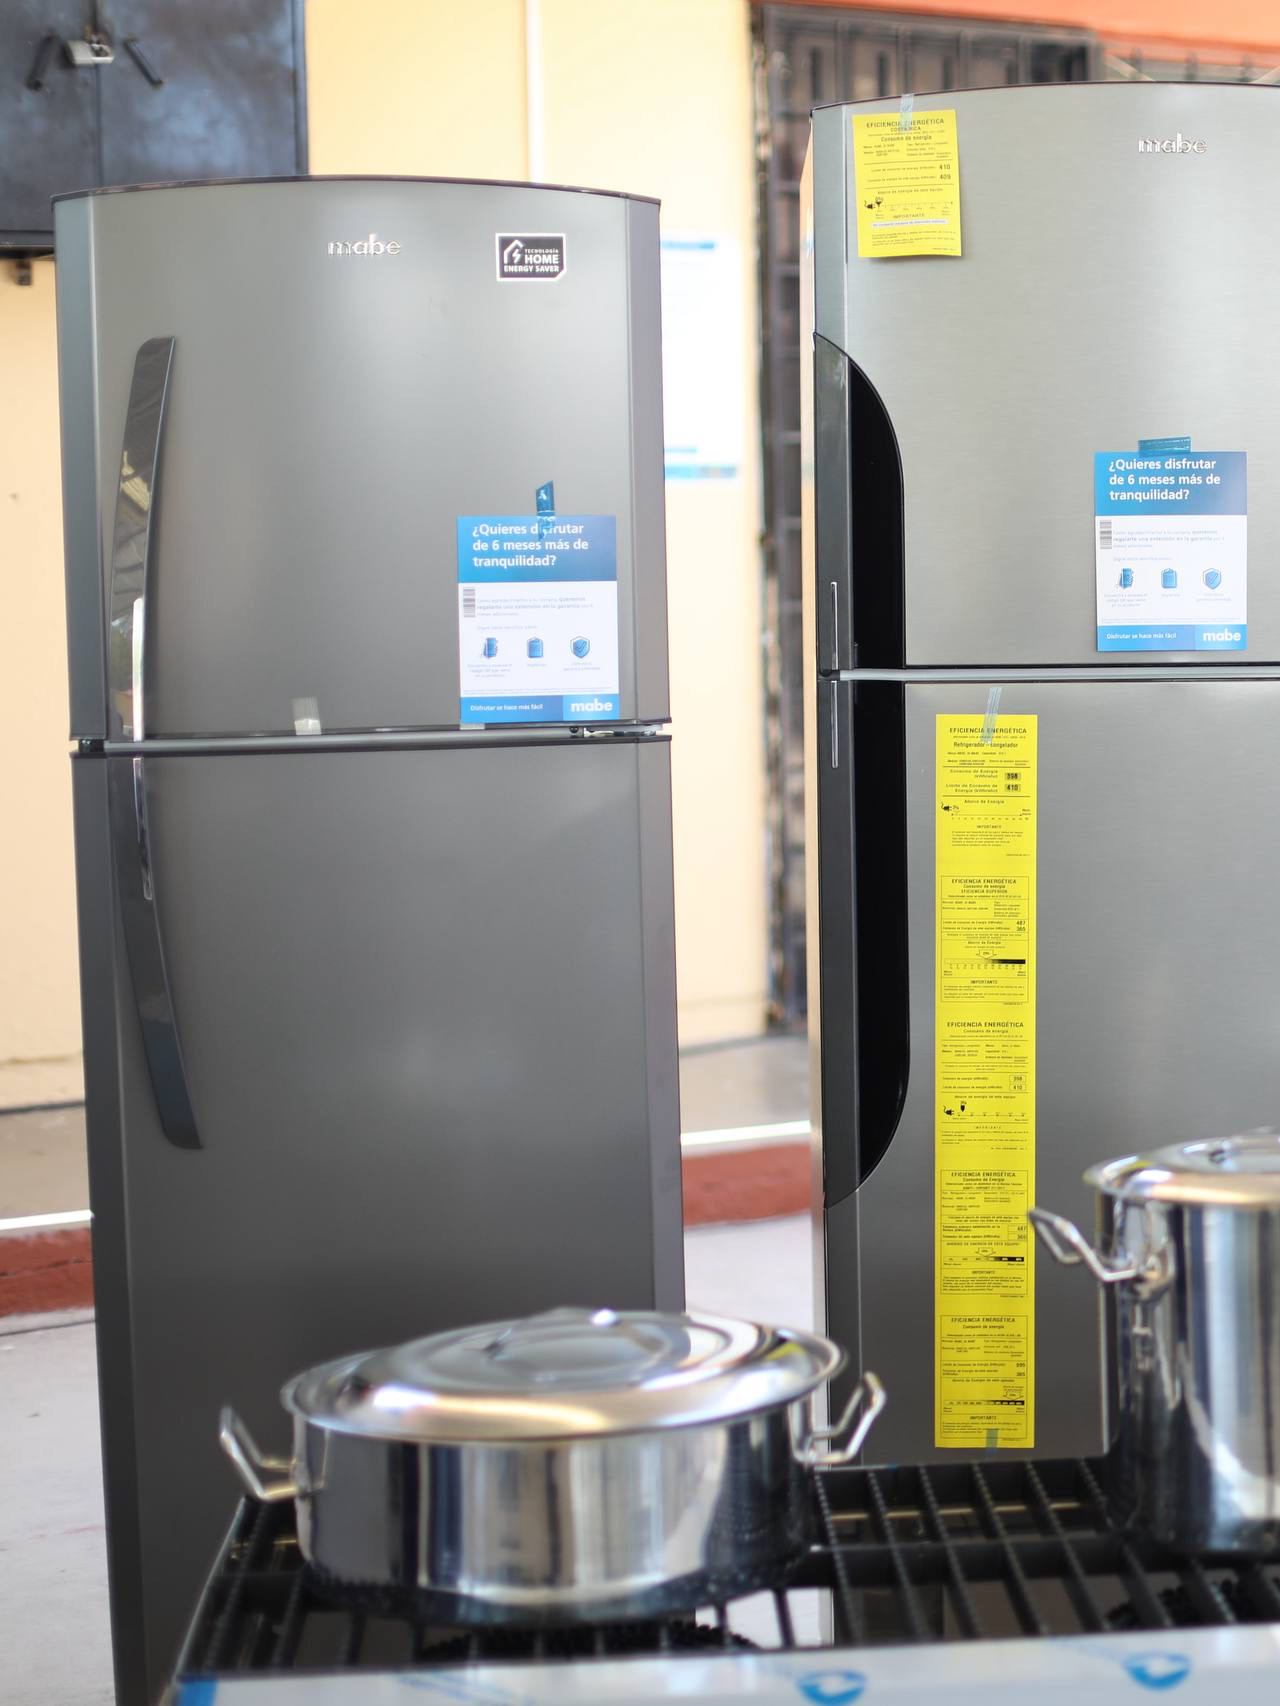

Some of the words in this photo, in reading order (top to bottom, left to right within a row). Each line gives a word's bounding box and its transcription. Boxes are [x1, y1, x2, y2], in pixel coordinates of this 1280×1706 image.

[905, 118, 945, 126] ERGÉTICA
[1138, 132, 1207, 153] mabe
[327, 234, 401, 255] mabe
[525, 254, 559, 264] HOME
[1109, 459, 1161, 472] ¿Quieres
[1164, 458, 1216, 469] disfrutar
[1109, 474, 1124, 485] de
[1127, 475, 1135, 485] 6
[1138, 476, 1175, 485] meses
[1178, 474, 1202, 485] más
[1205, 474, 1221, 485] de
[1109, 489, 1190, 502] tranquilidad?
[472, 523, 527, 537] ¿Quieres
[530, 523, 584, 535] drutar
[472, 540, 488, 551] de
[491, 541, 500, 551] 6
[503, 541, 541, 551] meses
[545, 539, 570, 550] más
[573, 539, 589, 550] de
[472, 555, 557, 569] tranquilidad?
[1203, 628, 1241, 641] mabe
[570, 698, 613, 712] mabe
[987, 726, 1027, 734] ENERGÉTICA
[984, 1020, 1024, 1028] ENERGÉTICA
